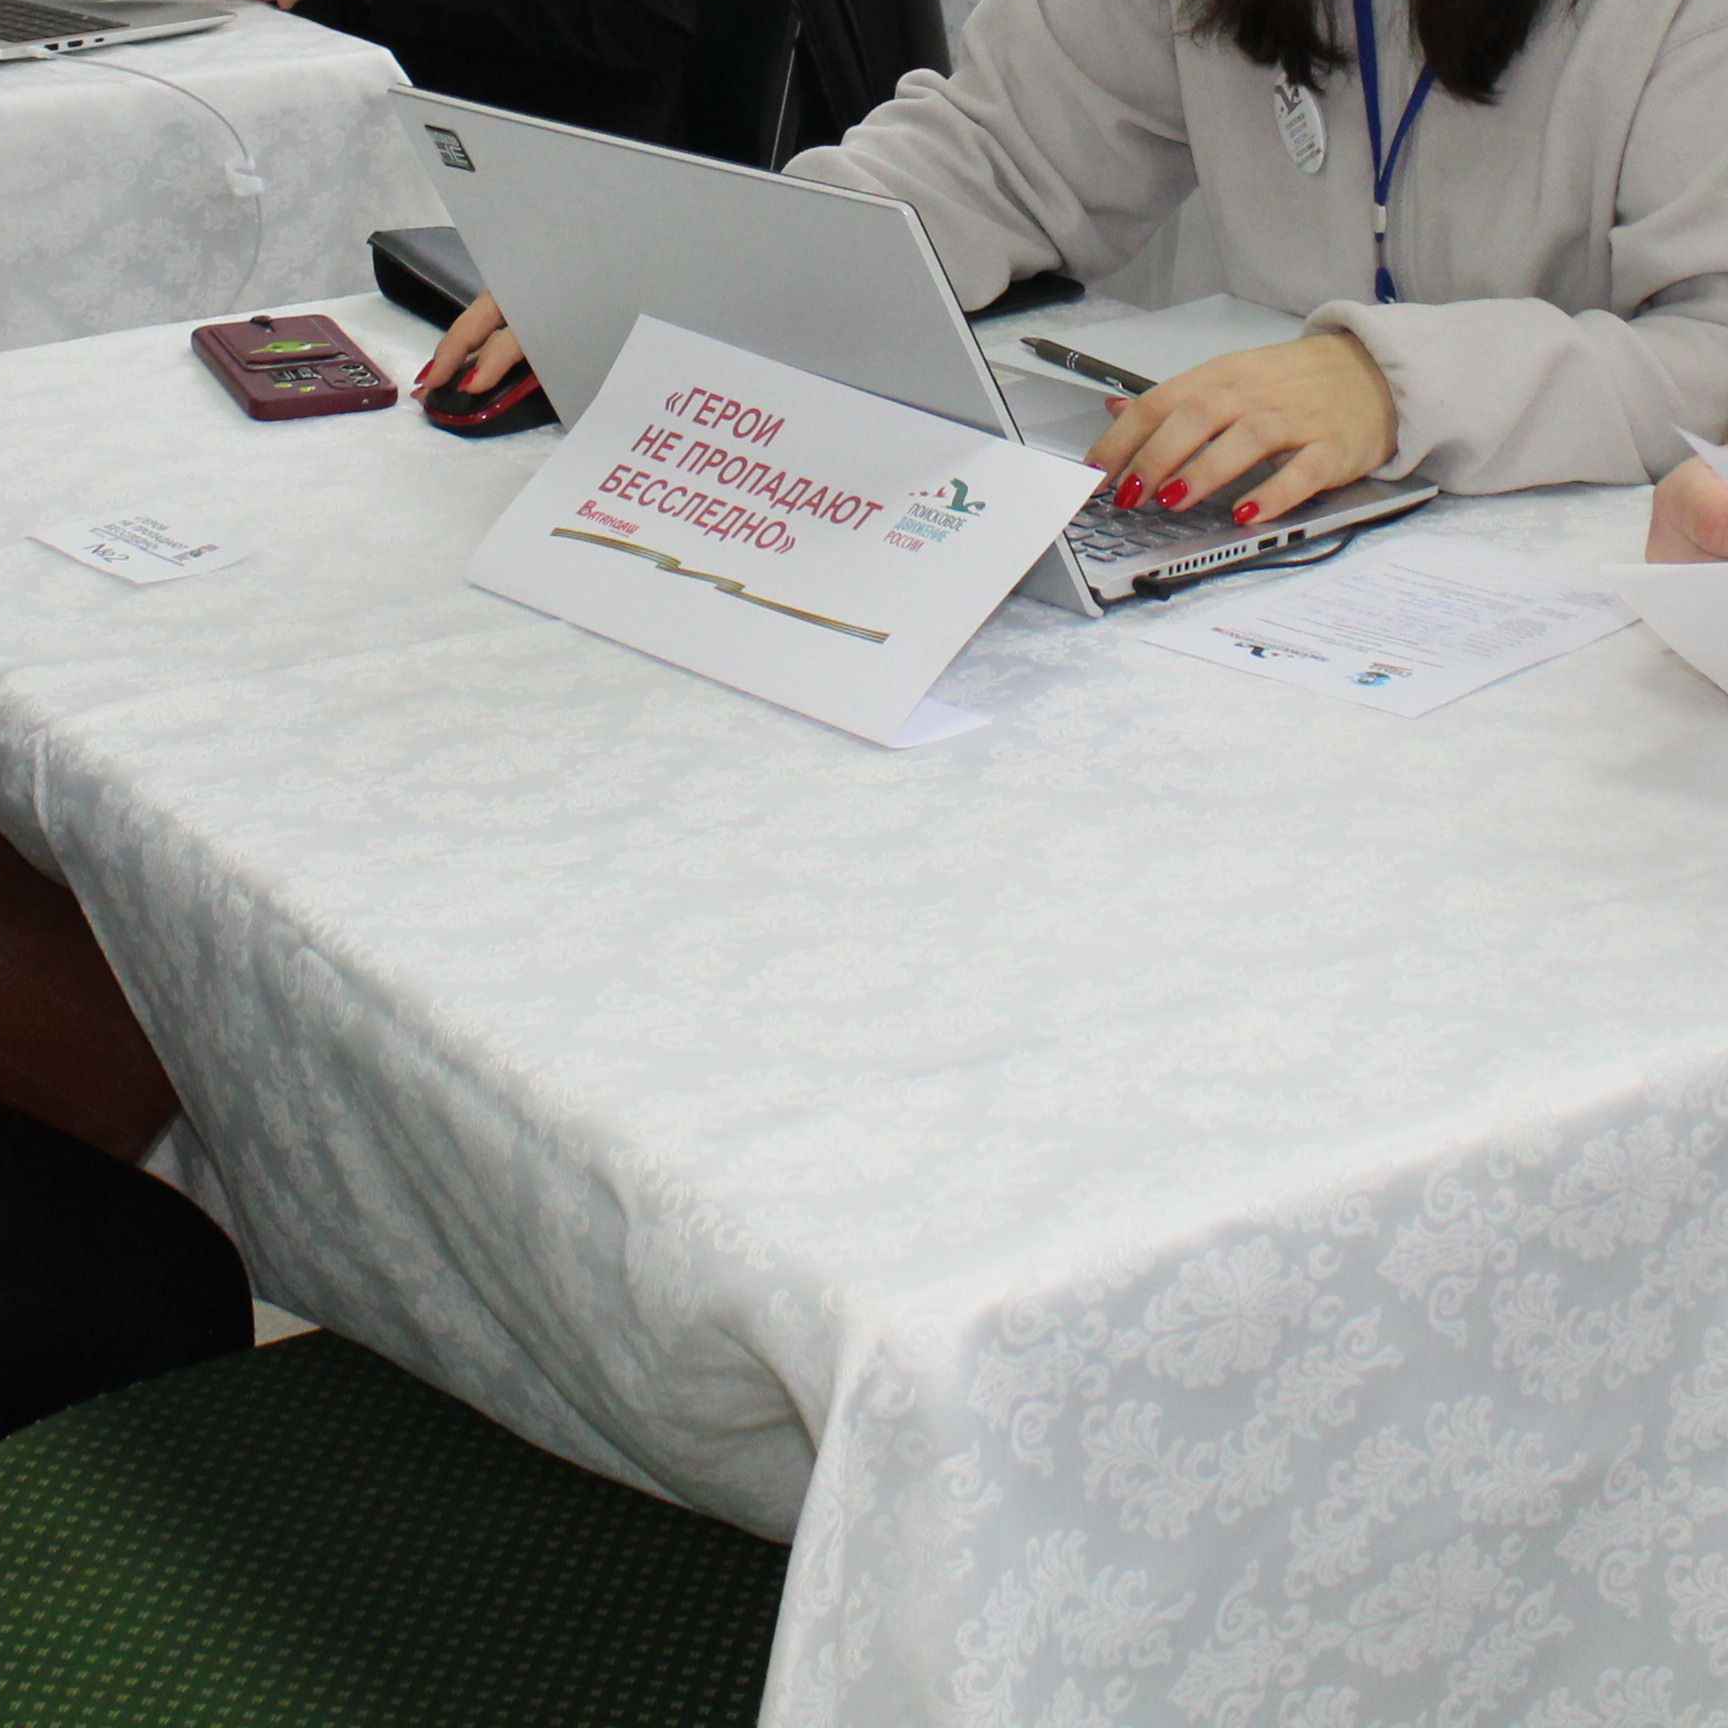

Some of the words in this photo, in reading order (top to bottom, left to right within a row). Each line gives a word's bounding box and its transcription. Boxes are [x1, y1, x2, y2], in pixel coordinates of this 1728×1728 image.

[665, 386, 785, 448] «ГЕРОИ
[631, 424, 683, 462] НЕ
[676, 441, 884, 531] ПРОПАДАЮТ
[599, 464, 796, 554] БЕССЛЕДНО»
[907, 503, 967, 532] ПОИСКОВОЕ
[883, 530, 924, 552] РОССИИ
